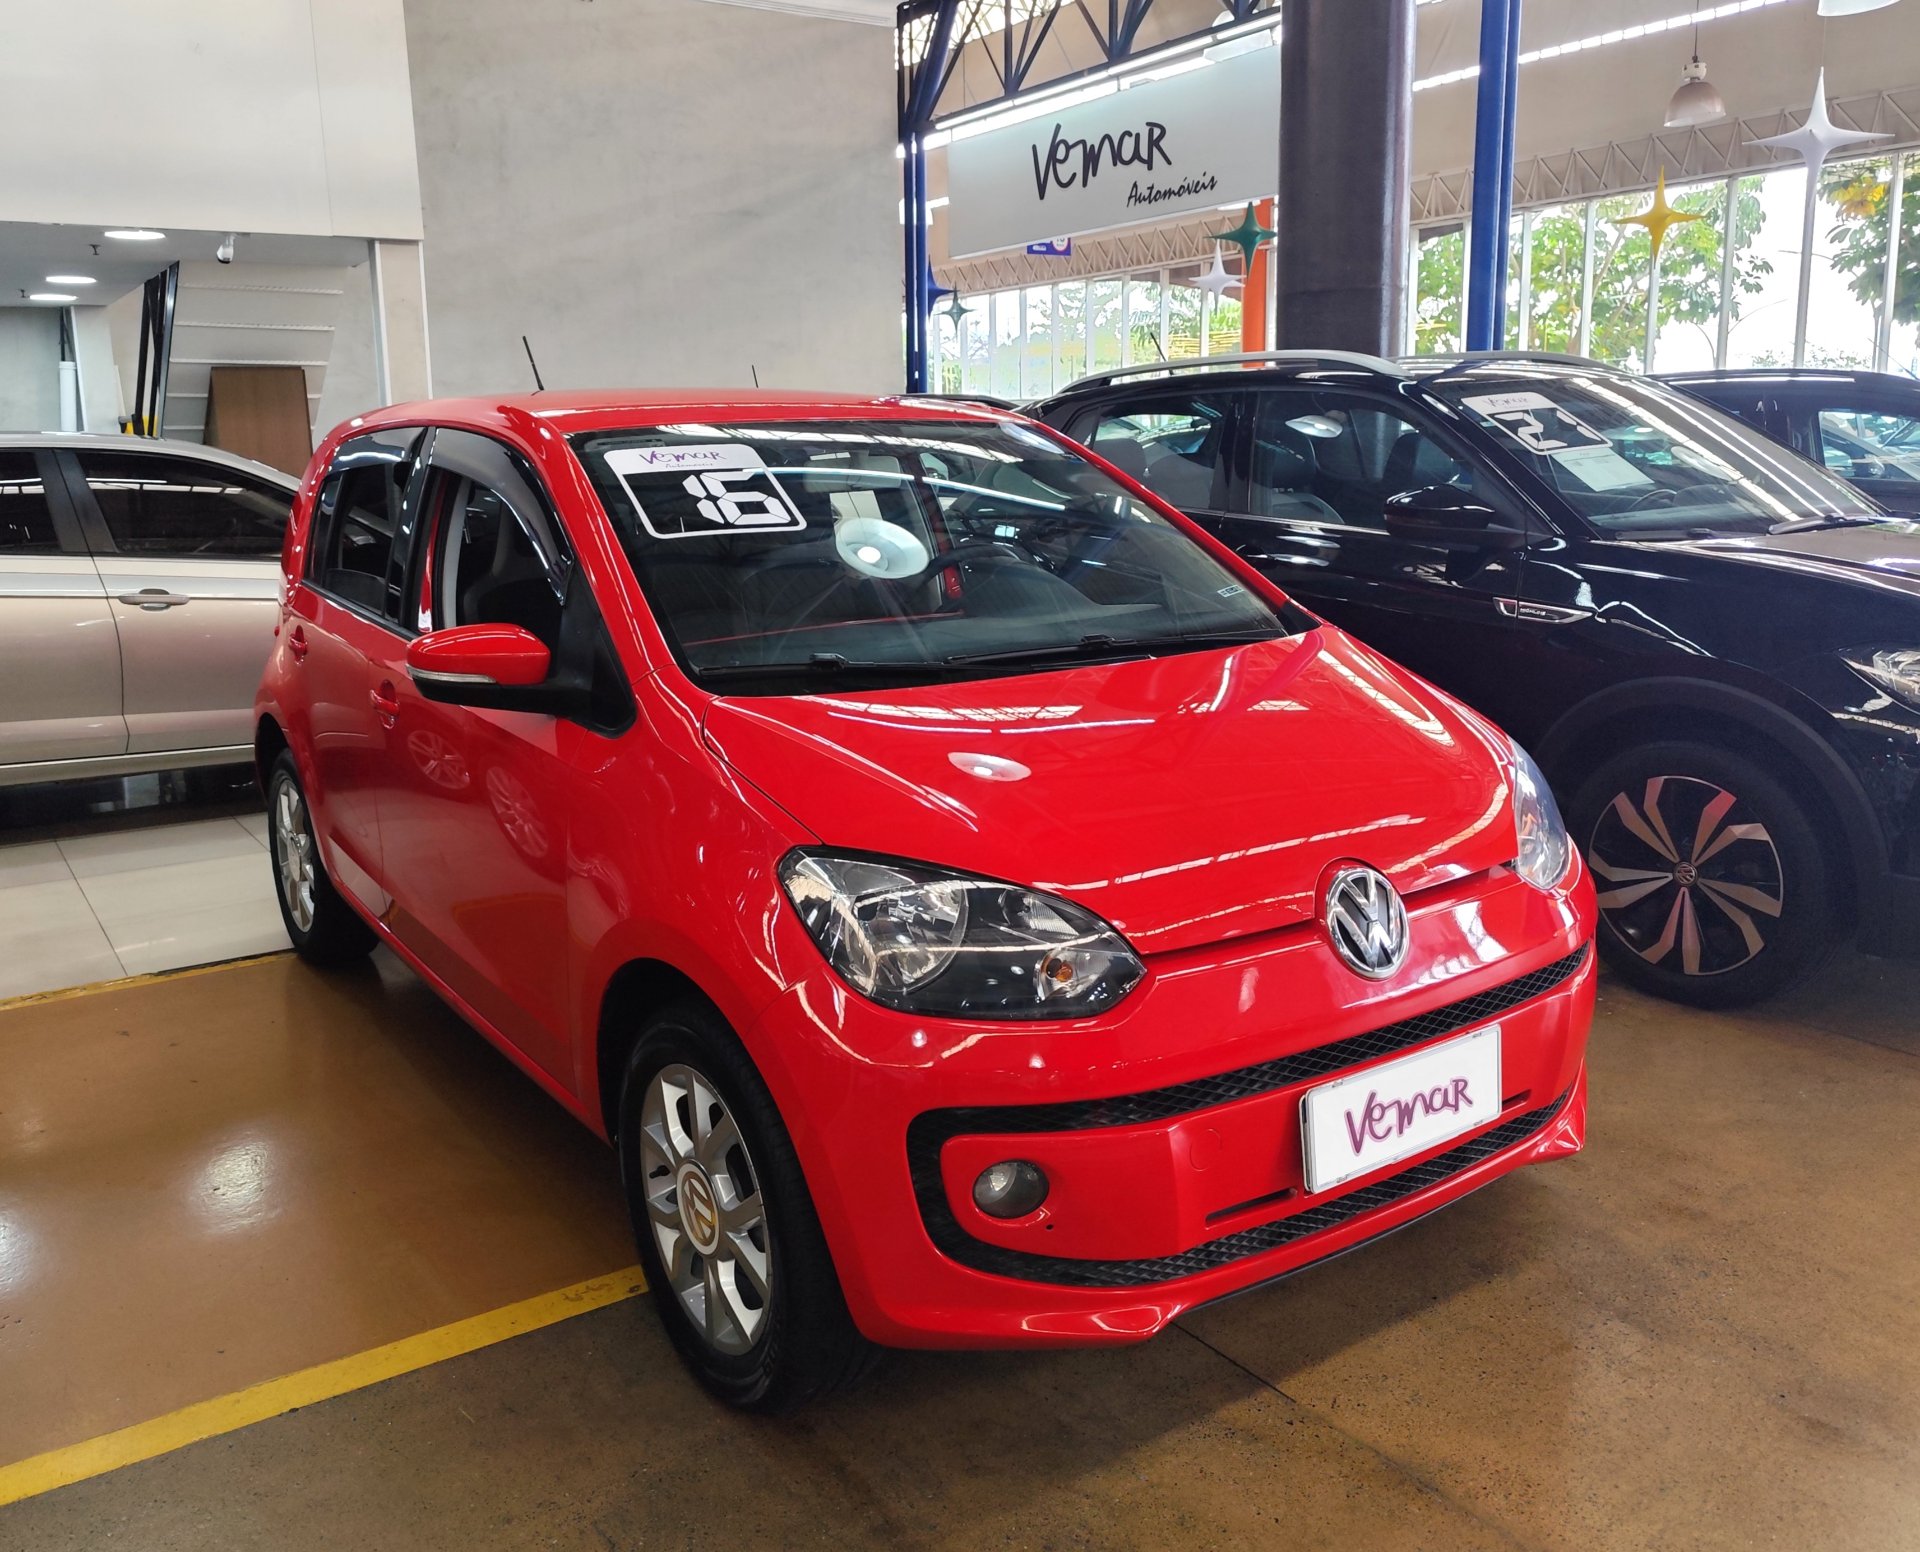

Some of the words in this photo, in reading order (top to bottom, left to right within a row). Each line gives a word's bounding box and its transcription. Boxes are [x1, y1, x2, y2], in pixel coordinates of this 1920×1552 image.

[1126, 171, 1218, 208] Automóveis
[1493, 409, 1602, 450] 21
[682, 471, 792, 526] 16
